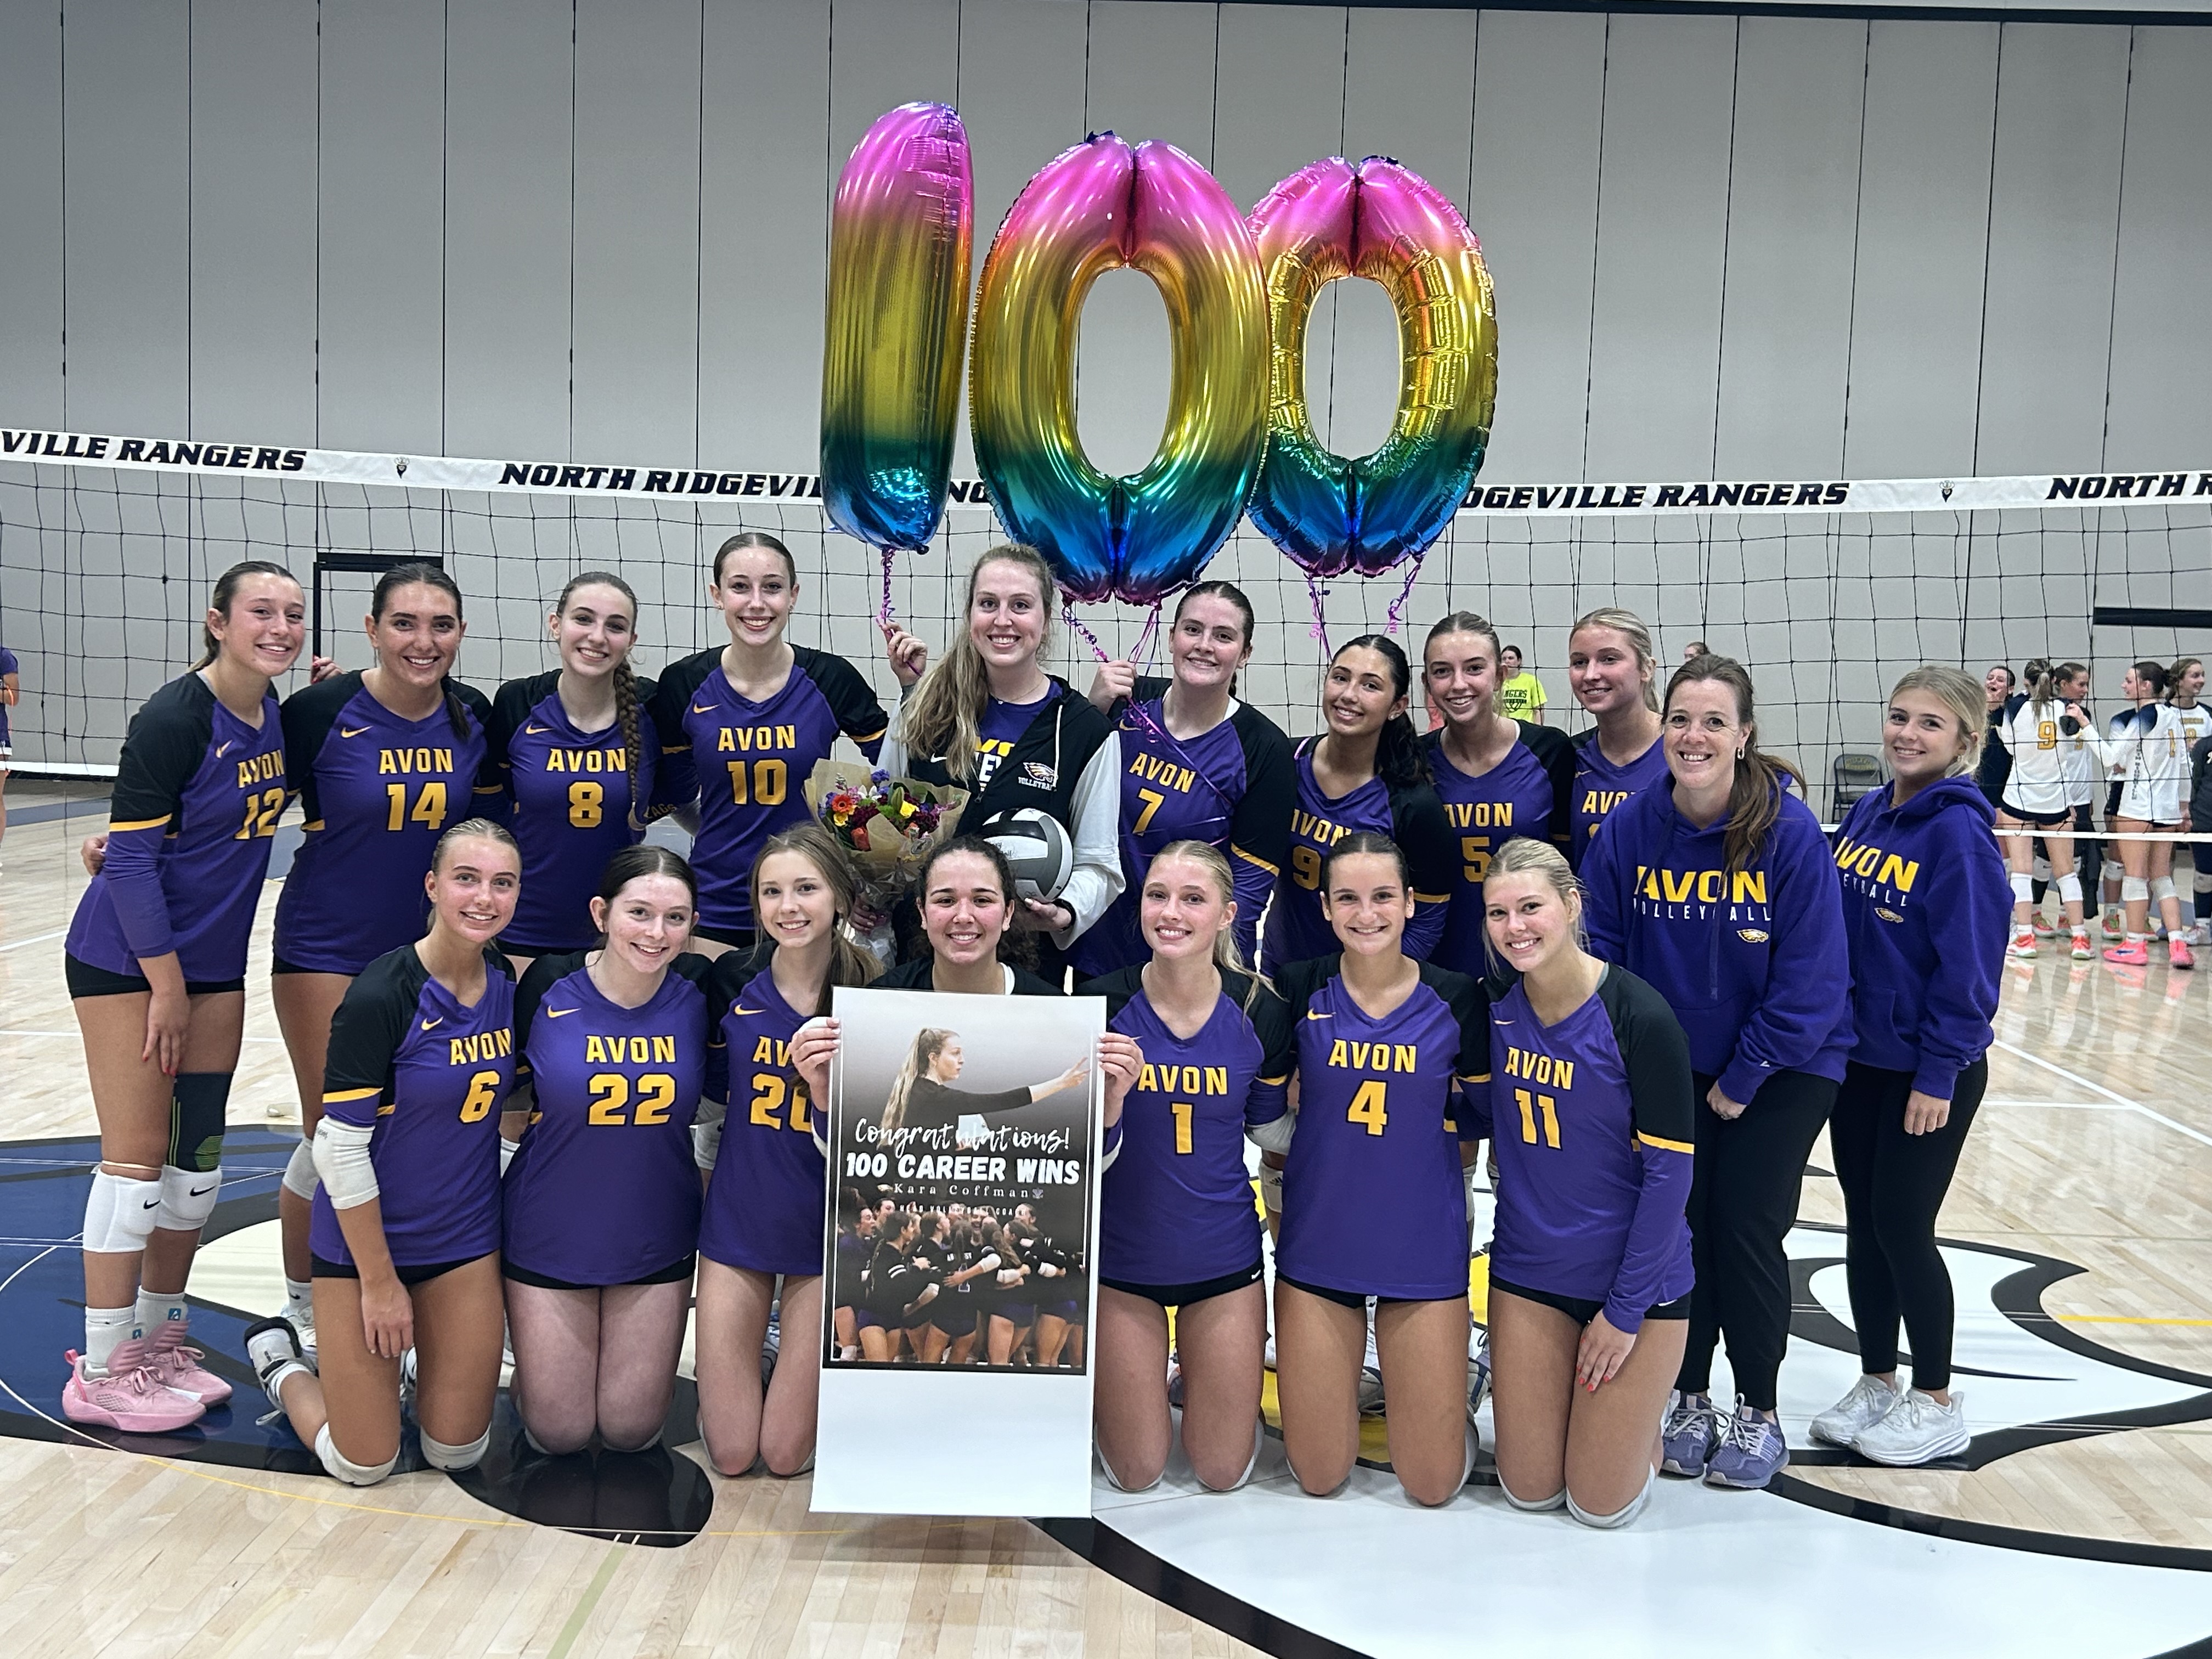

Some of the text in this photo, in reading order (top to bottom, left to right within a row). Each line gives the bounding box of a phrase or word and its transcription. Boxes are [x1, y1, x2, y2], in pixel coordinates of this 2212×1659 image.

[1, 431, 307, 471] VILLE RANGERS
[498, 463, 637, 490] NORTH
[1652, 482, 1849, 507] RANGERS
[2045, 473, 2188, 500] NORTH
[717, 725, 796, 752] AVON
[2037, 720, 2057, 751] 9
[237, 749, 285, 788] AVON
[379, 747, 454, 775] AVON
[546, 747, 627, 773] AVON
[1128, 752, 1197, 793] AVON
[726, 758, 788, 806] 10
[234, 787, 286, 840] 12
[387, 782, 448, 831] 14
[568, 780, 604, 828] 8
[1132, 788, 1165, 836] 7
[1581, 791, 1635, 814] AVO
[1293, 845, 1322, 890] 9
[1461, 836, 1492, 883] 5
[1633, 865, 1768, 904] AVON
[1633, 898, 1771, 921] OLLEYALL
[449, 1027, 512, 1066] AVON
[585, 1035, 676, 1064] AVON
[1328, 1039, 1417, 1074] AVON
[1136, 1063, 1228, 1096] AVON
[1504, 1045, 1575, 1091] AVON
[459, 1069, 501, 1124] 6
[587, 1073, 676, 1126] 22
[1346, 1080, 1389, 1137] 4
[1169, 1102, 1194, 1155] 1
[1514, 1087, 1562, 1149] 11
[847, 1152, 1081, 1185] 100 CAREER WINS
[894, 1183, 1029, 1199] Kara Coffman
